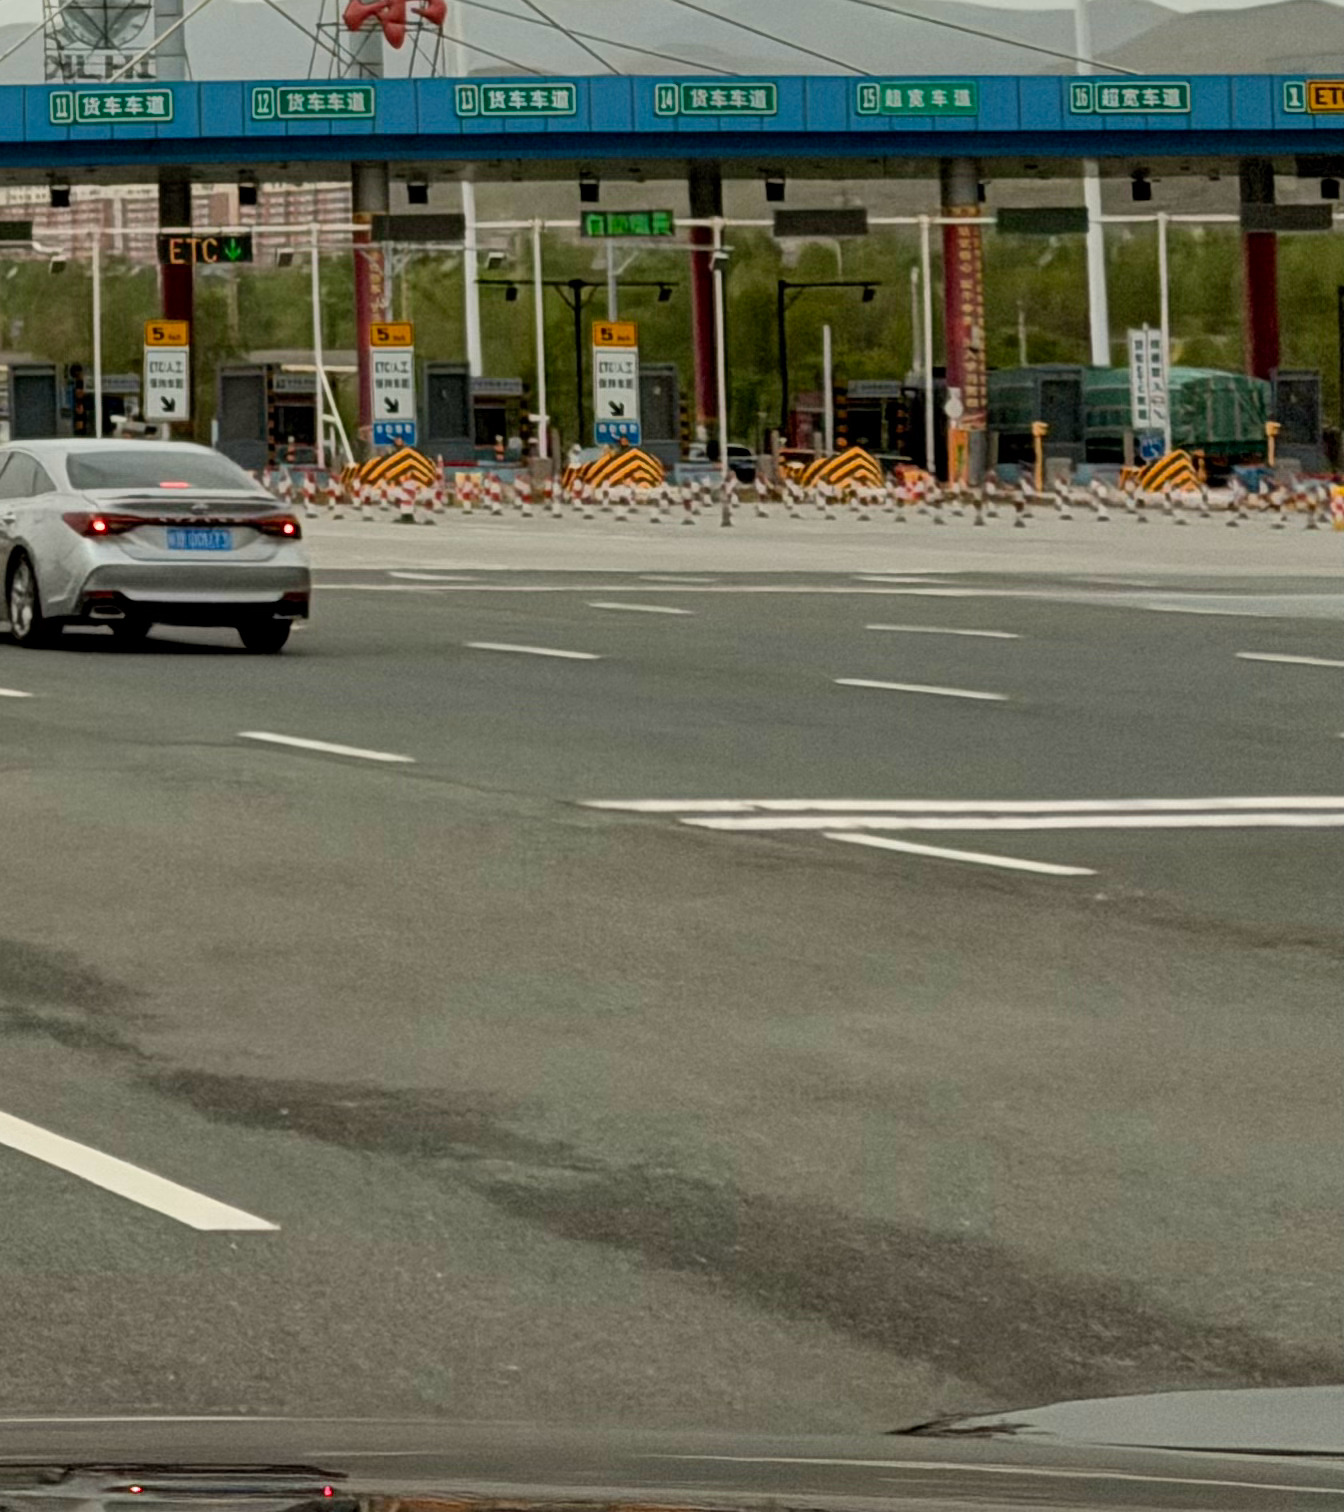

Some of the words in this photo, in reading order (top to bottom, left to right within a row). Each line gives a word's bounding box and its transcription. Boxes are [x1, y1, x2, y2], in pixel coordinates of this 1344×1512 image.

[55, 97, 69, 118] 11
[82, 95, 166, 117] 货车车道
[256, 93, 270, 114] 12
[285, 91, 367, 113] 货车车道
[461, 88, 474, 110] 13
[487, 89, 570, 110] 货车车道
[660, 87, 674, 109] 14
[689, 88, 768, 110] 货车车道
[862, 87, 876, 109] 15
[1075, 87, 1089, 108] 16
[1314, 86, 1344, 106] ET
[169, 237, 219, 265] ETC
[151, 326, 165, 342] 5
[376, 327, 391, 342] 5
[600, 327, 614, 342] 5
